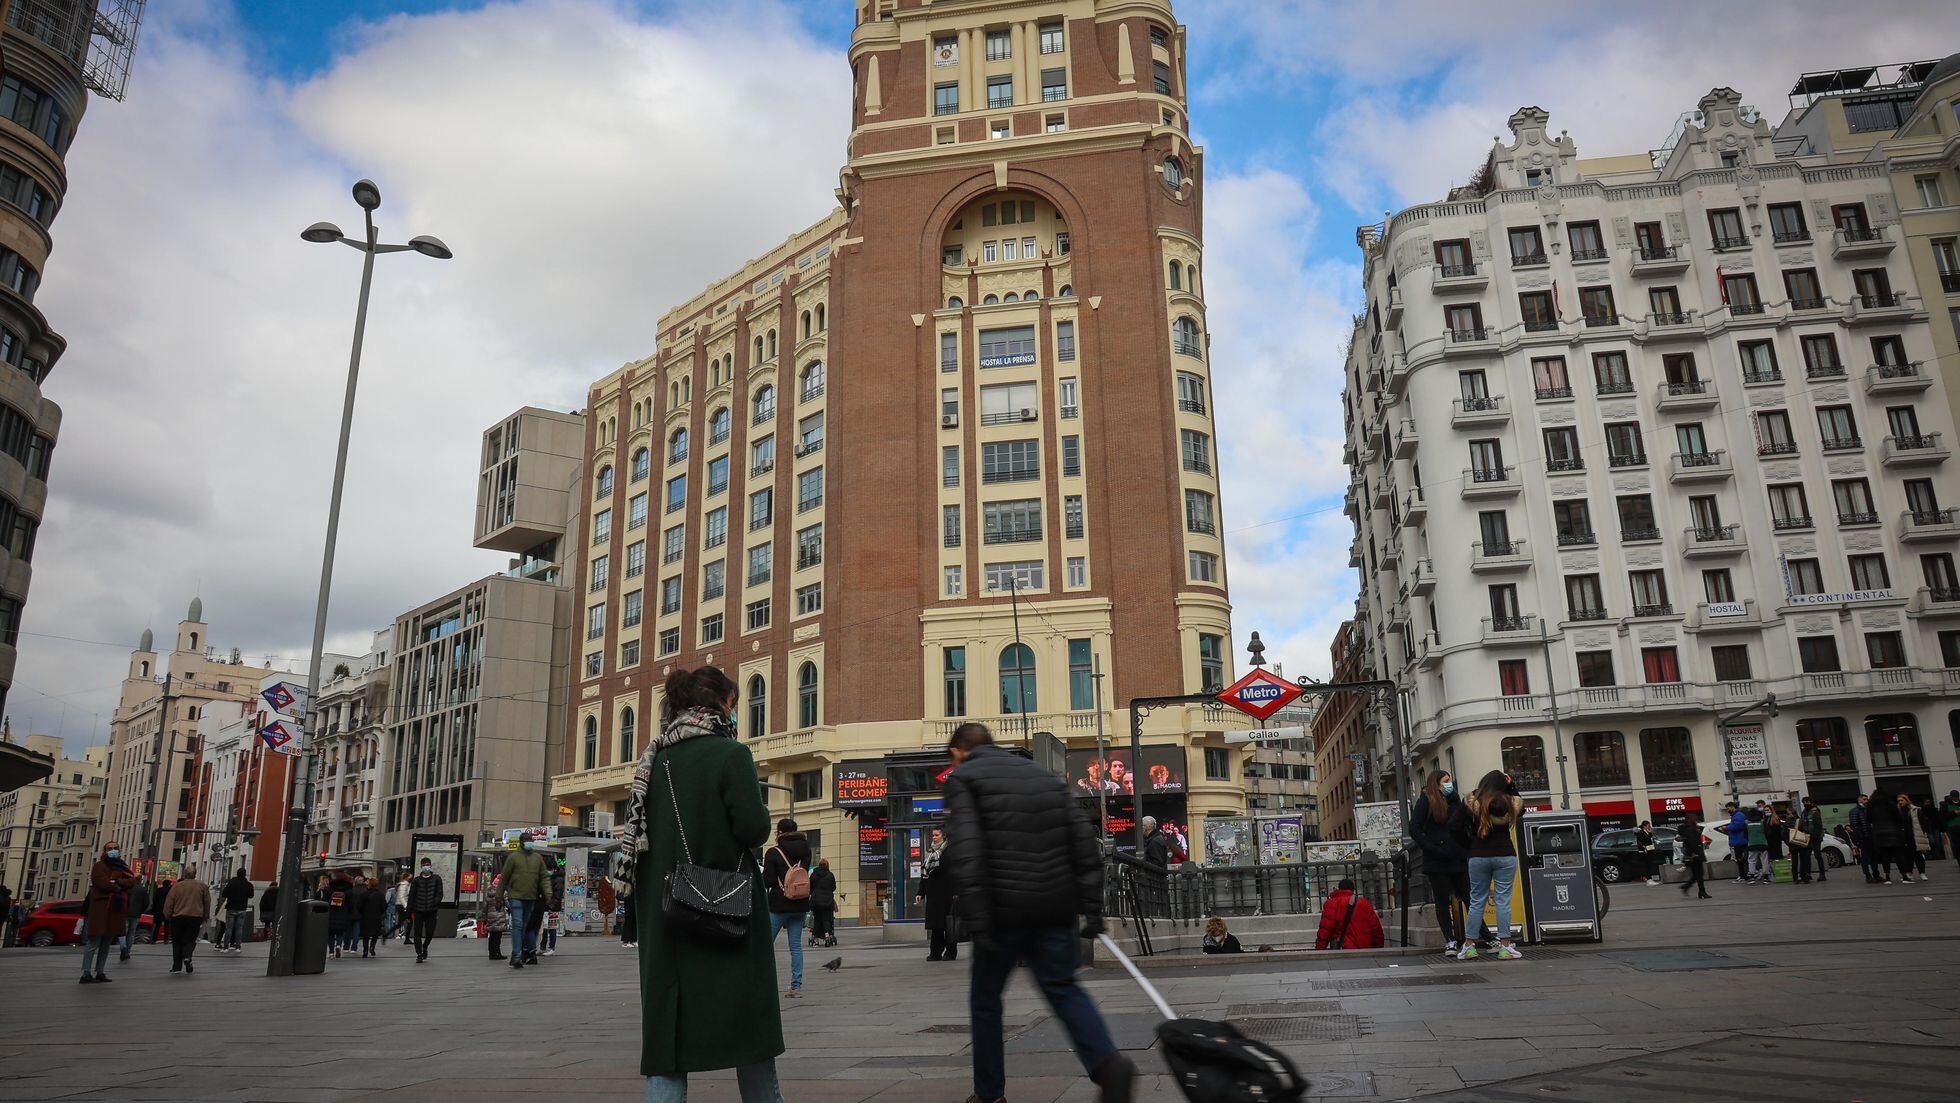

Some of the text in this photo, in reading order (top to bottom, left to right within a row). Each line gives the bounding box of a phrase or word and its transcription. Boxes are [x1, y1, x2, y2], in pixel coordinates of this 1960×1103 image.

[981, 358, 1003, 366] HOSTAL
[1012, 355, 1035, 364] PRENSA
[1808, 590, 1893, 603] CONTINENTAL
[1709, 604, 1744, 614] HOSTAL
[1243, 687, 1278, 700] Metro
[1248, 730, 1280, 740] Callao
[1729, 727, 1761, 735] ALQUILER
[848, 771, 857, 779] 27
[838, 776, 888, 789] PERIBÁÑE
[838, 789, 849, 799] EL
